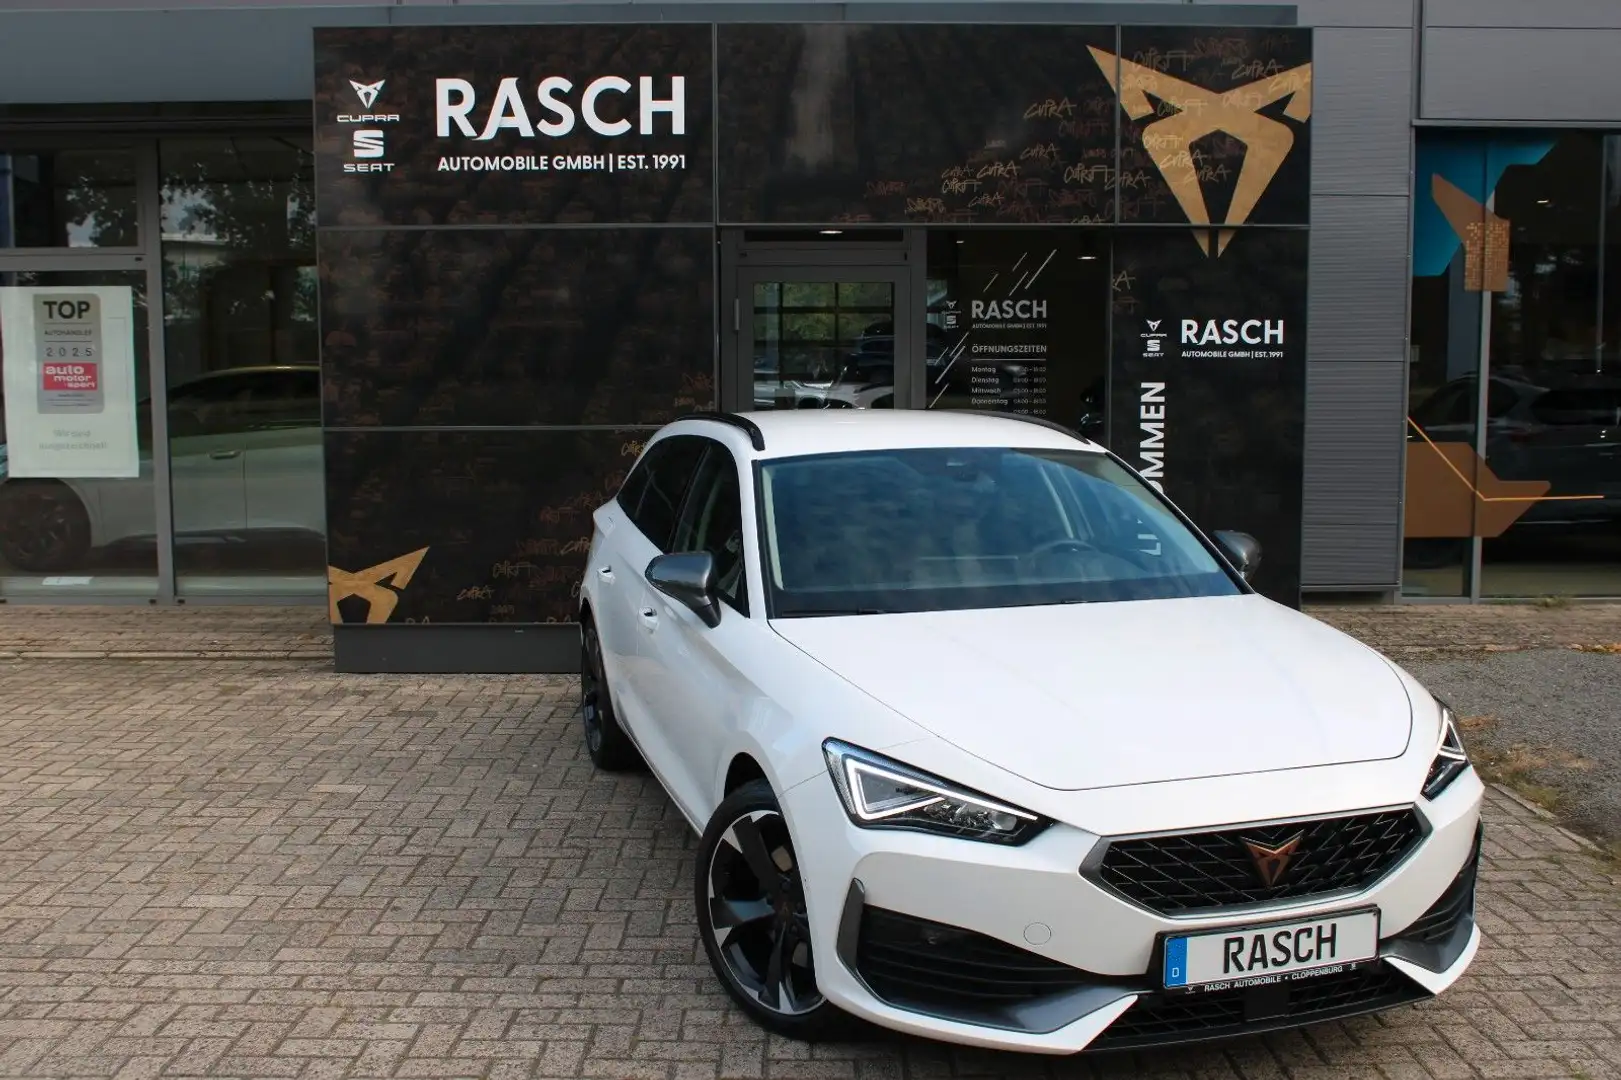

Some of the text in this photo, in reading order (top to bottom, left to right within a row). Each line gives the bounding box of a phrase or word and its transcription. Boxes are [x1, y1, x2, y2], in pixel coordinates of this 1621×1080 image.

[435, 76, 685, 141] RASCH
[343, 163, 395, 172] SEAT
[438, 155, 548, 172] AUTOMOBILE
[652, 154, 685, 170] 1991
[43, 301, 90, 319] TOP
[971, 300, 1047, 320] RASCH
[1181, 319, 1284, 345] RASCH
[971, 343, 1047, 353] ÖFFNUNGSZEITEN
[45, 365, 85, 375] auto
[971, 366, 997, 374] Montag
[1223, 923, 1337, 974] RASCH
[1171, 967, 1180, 978] D
[1204, 982, 1231, 992] RASCH
[1233, 976, 1282, 988] AUTOMOBILE
[1291, 965, 1343, 981] CLOPPENBURG
